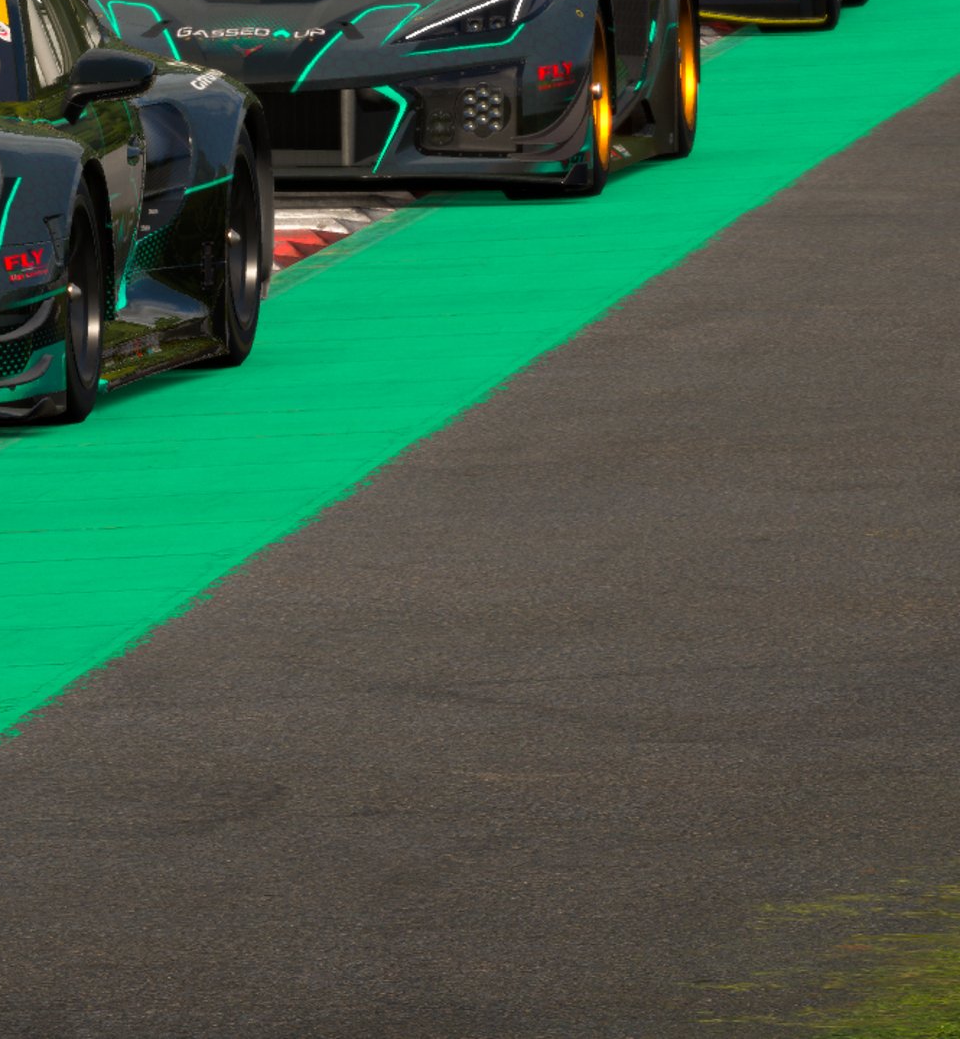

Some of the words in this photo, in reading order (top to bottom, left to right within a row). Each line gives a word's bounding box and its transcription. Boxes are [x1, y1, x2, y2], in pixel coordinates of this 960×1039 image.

[176, 26, 271, 39] GASSED
[293, 27, 326, 39] UP
[537, 60, 573, 82] FLY
[3, 247, 45, 273] FLY
